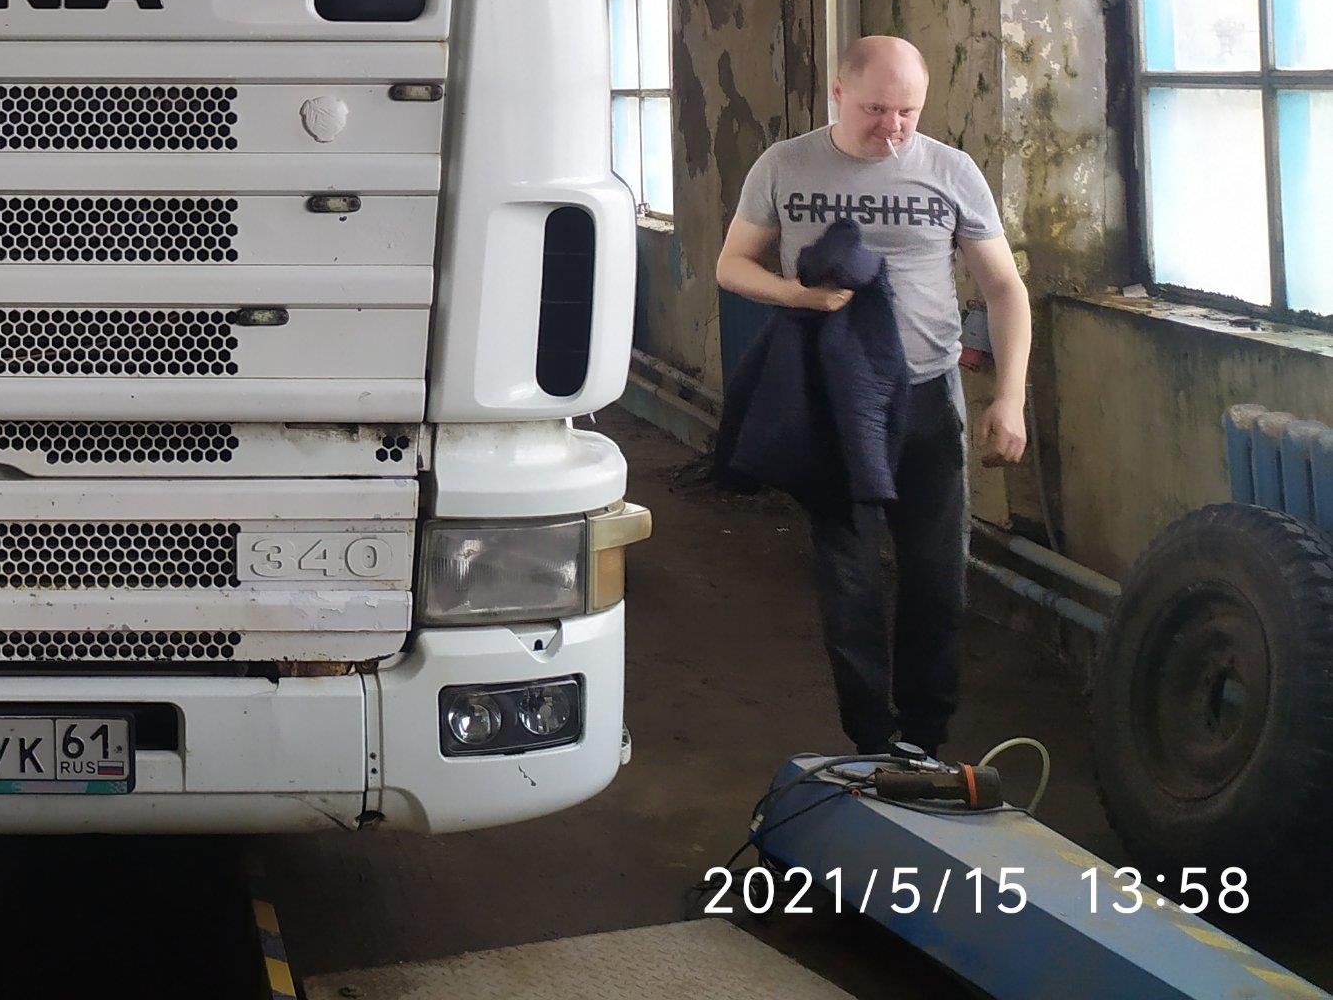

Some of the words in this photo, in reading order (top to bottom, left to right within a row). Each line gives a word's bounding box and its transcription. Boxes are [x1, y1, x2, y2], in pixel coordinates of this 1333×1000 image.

[785, 193, 947, 227] CRUSHER
[250, 536, 393, 578] 340
[62, 723, 110, 760] 61
[60, 761, 96, 774] RUS
